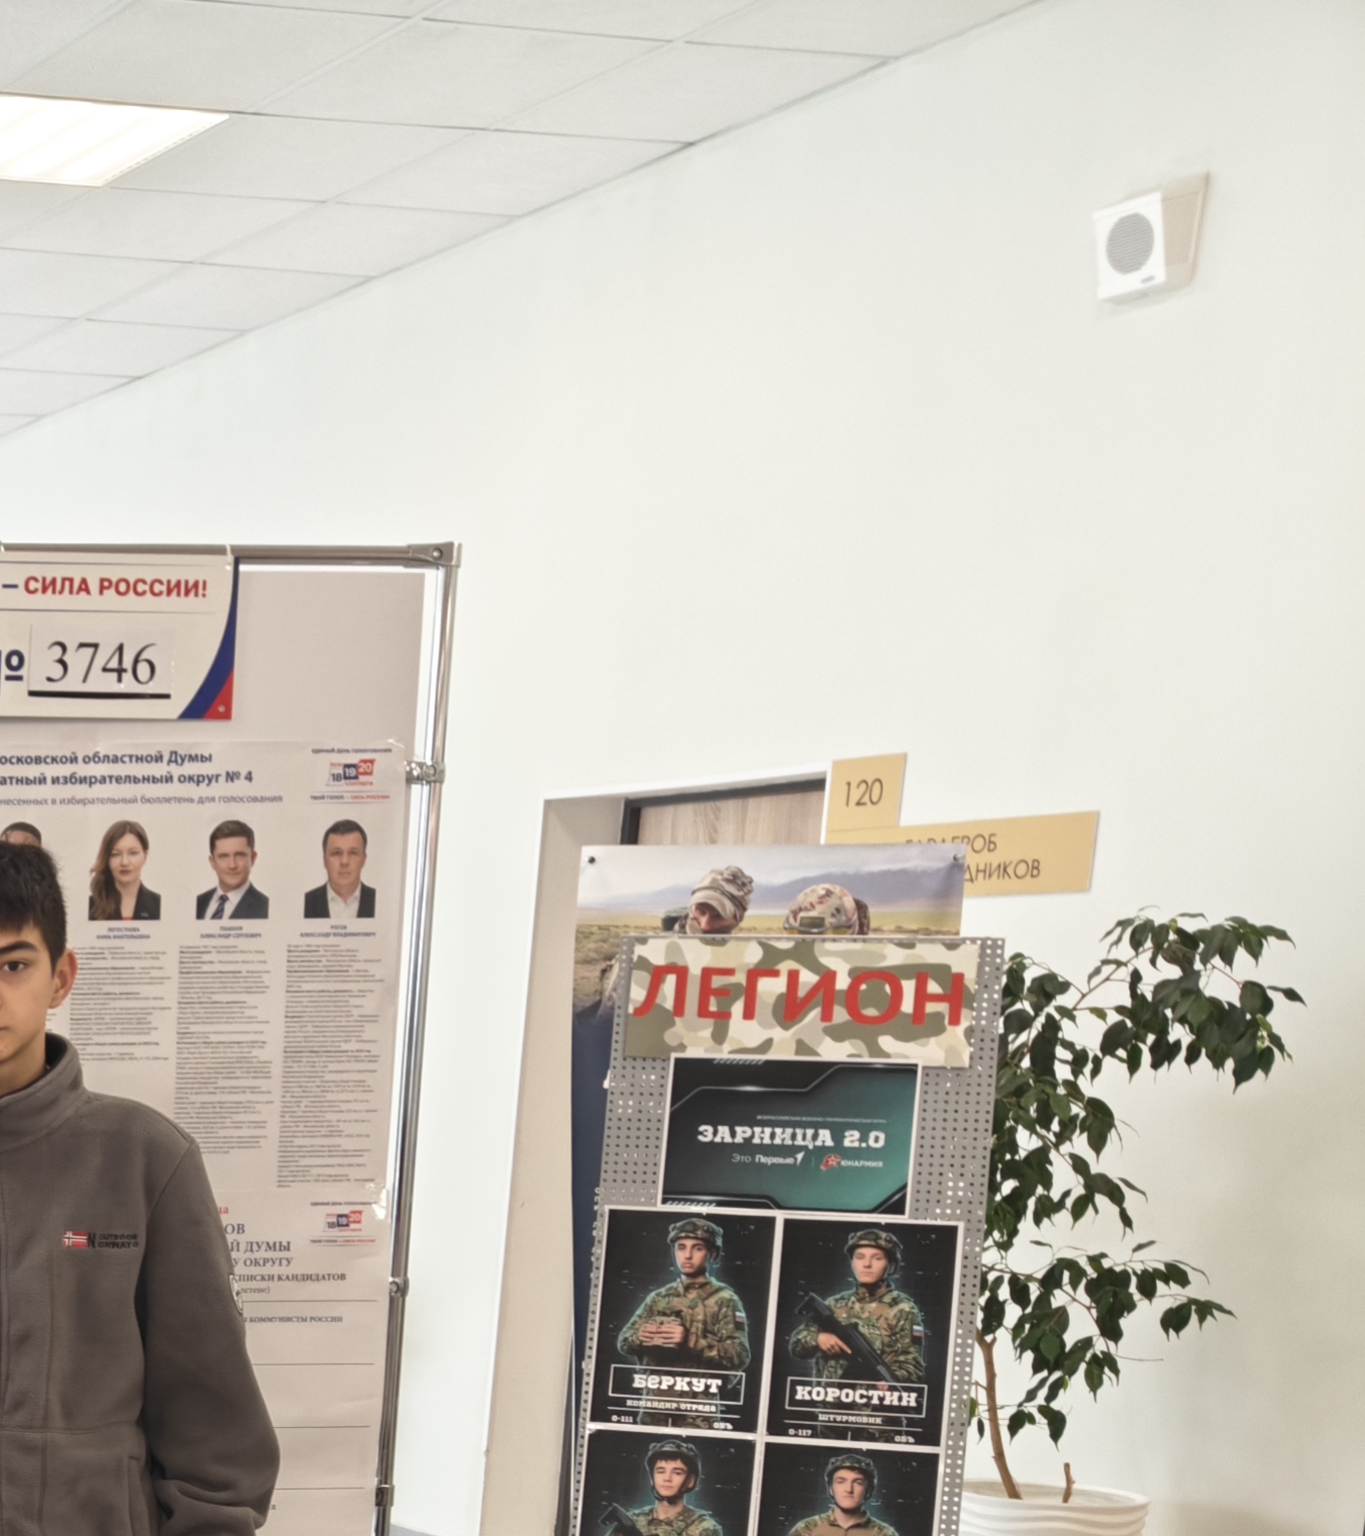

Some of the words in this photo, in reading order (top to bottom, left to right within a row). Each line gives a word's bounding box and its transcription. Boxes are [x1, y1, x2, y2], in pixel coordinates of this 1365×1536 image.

[23, 575, 92, 597] СИЛА
[99, 577, 208, 599] РОССИИ!
[44, 640, 158, 686] 3746
[82, 751, 164, 765] областной
[166, 750, 213, 766] Думы
[344, 767, 356, 777] 19
[358, 762, 372, 773] 20
[50, 770, 174, 788] избирательный
[177, 772, 222, 787] округ
[243, 770, 254, 783] 4
[331, 773, 342, 782] 18
[844, 778, 884, 808] 120
[964, 859, 1041, 884] ДНИКОВ
[632, 965, 966, 1027] ЛЕГИОН
[697, 1125, 835, 1150] ЗАРНИЦА
[843, 1130, 886, 1149] 2.0
[731, 1153, 752, 1164] Это
[755, 1154, 795, 1166] Первые
[840, 1159, 884, 1168] ЮНАРМИЯ
[243, 1241, 291, 1254] ДУМЫ
[243, 1257, 294, 1268] ОКРУГУ
[276, 1273, 347, 1283] КАНДИДАТОВ
[794, 1385, 918, 1408] КОРОСТИН
